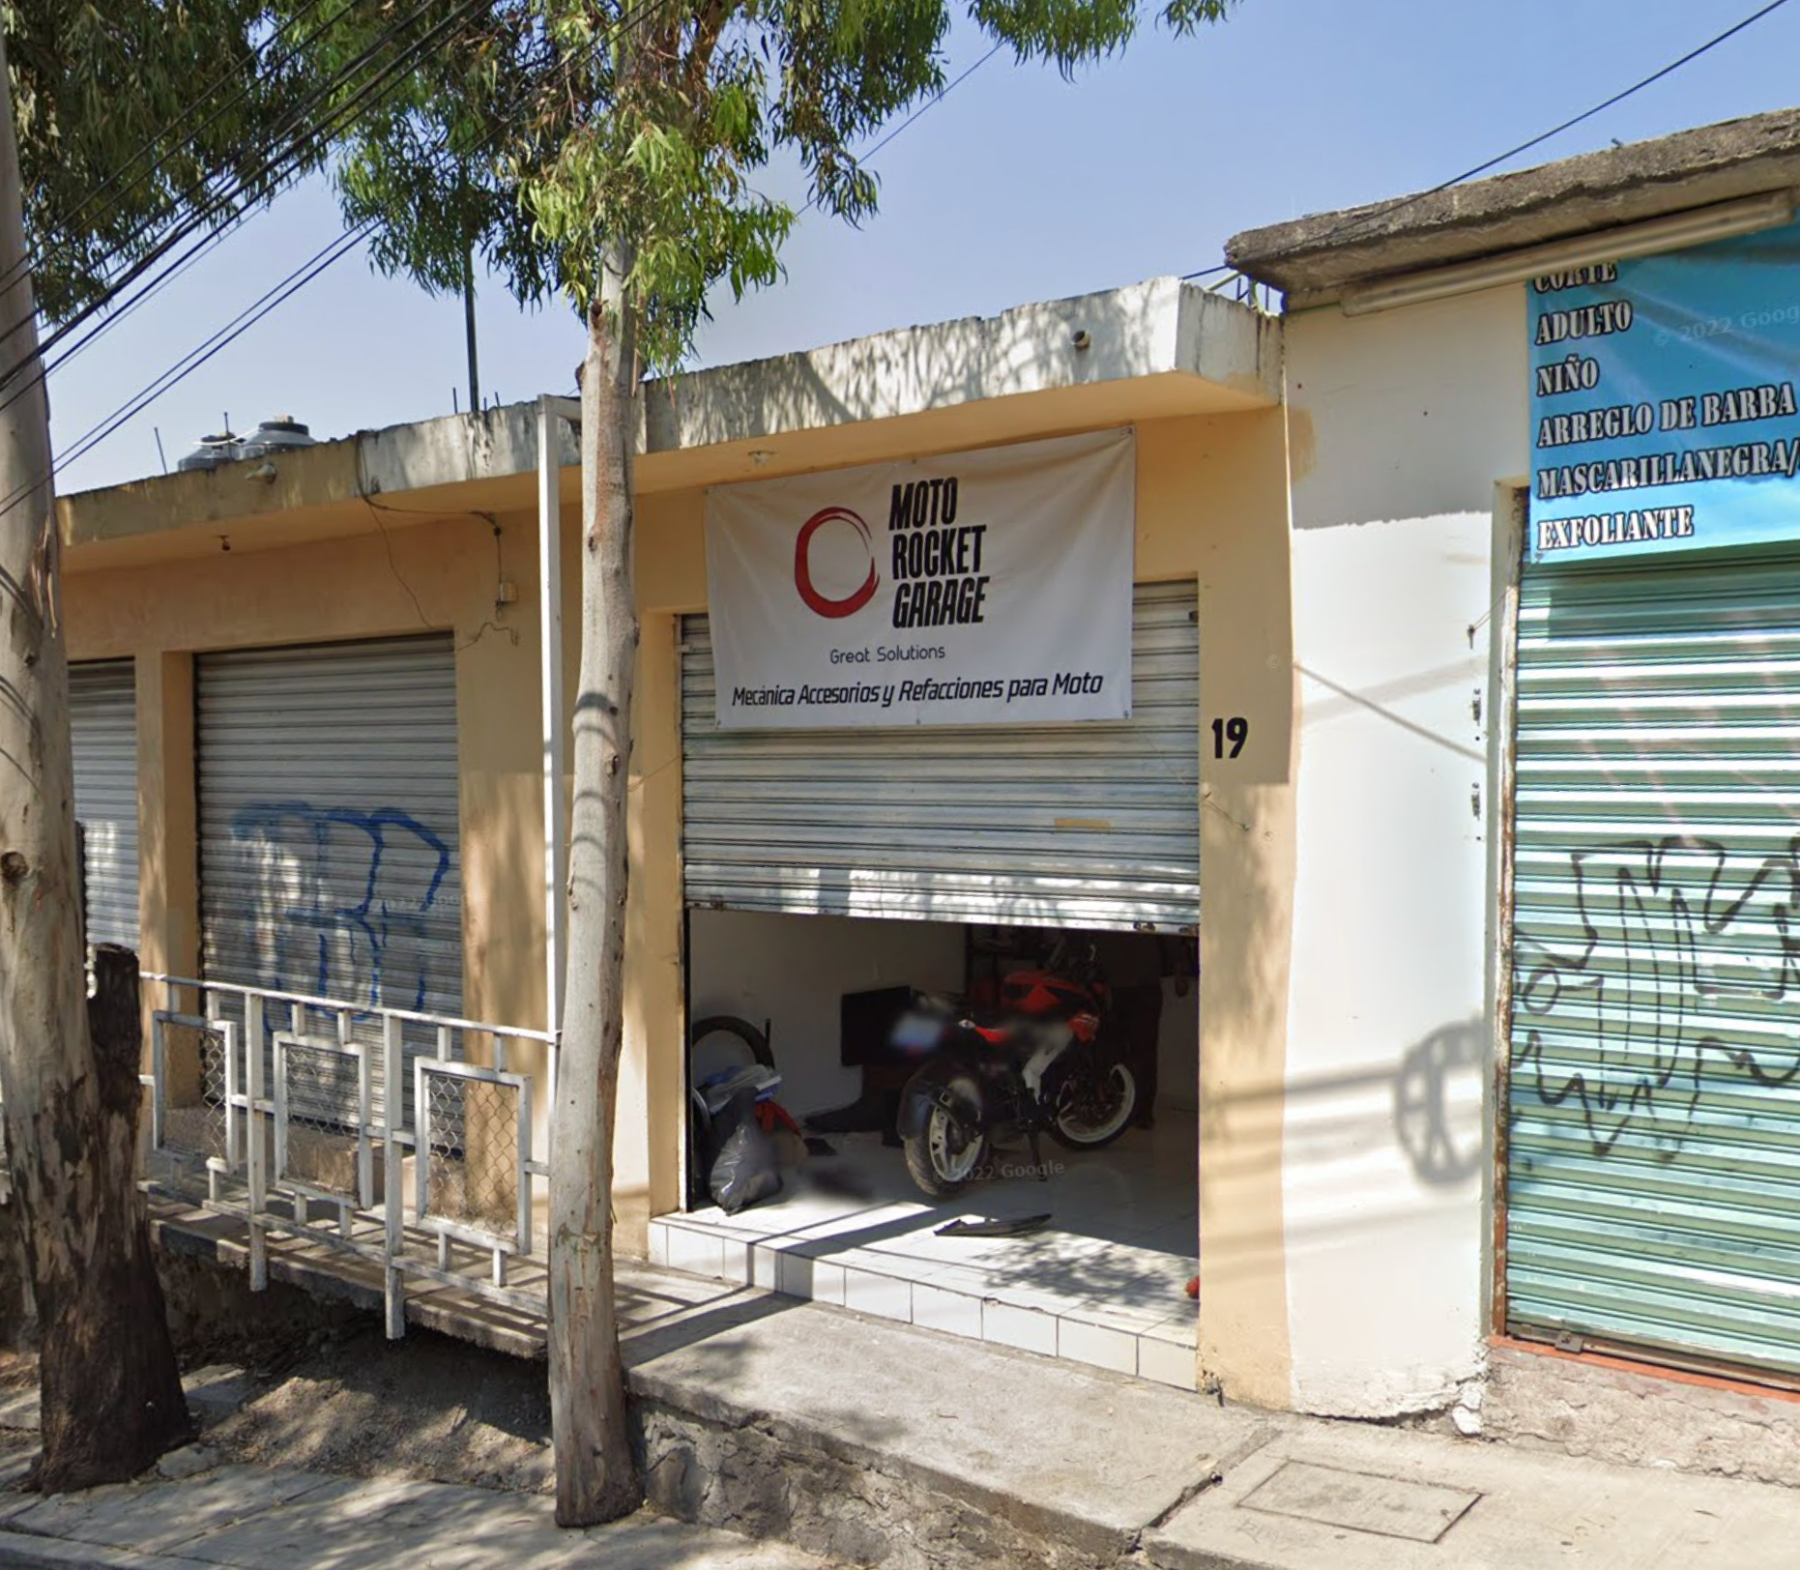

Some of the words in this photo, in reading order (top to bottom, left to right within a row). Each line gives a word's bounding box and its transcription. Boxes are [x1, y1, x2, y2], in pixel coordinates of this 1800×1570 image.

[1535, 300, 1632, 346] ADULTO
[1537, 354, 1599, 396] NIÑO
[1537, 402, 1654, 448] ARREGLO
[1659, 395, 1696, 431] DE
[1701, 381, 1797, 427] BARBA
[1537, 437, 1800, 500] MASCARILLANEGRA/
[889, 476, 958, 530] MOTO
[1537, 504, 1694, 550] EXFOLIANTE
[892, 524, 987, 580] ROCKET
[893, 576, 990, 629] GARAGE
[830, 647, 871, 664] Great
[877, 644, 946, 662] Solutions
[732, 684, 796, 706] Mecánica
[797, 681, 881, 705] Accesorios
[881, 684, 895, 708] y
[899, 677, 1004, 702] Refacciones
[1006, 678, 1049, 703] para
[1052, 671, 1104, 695] Moto
[1211, 716, 1249, 759] 19
